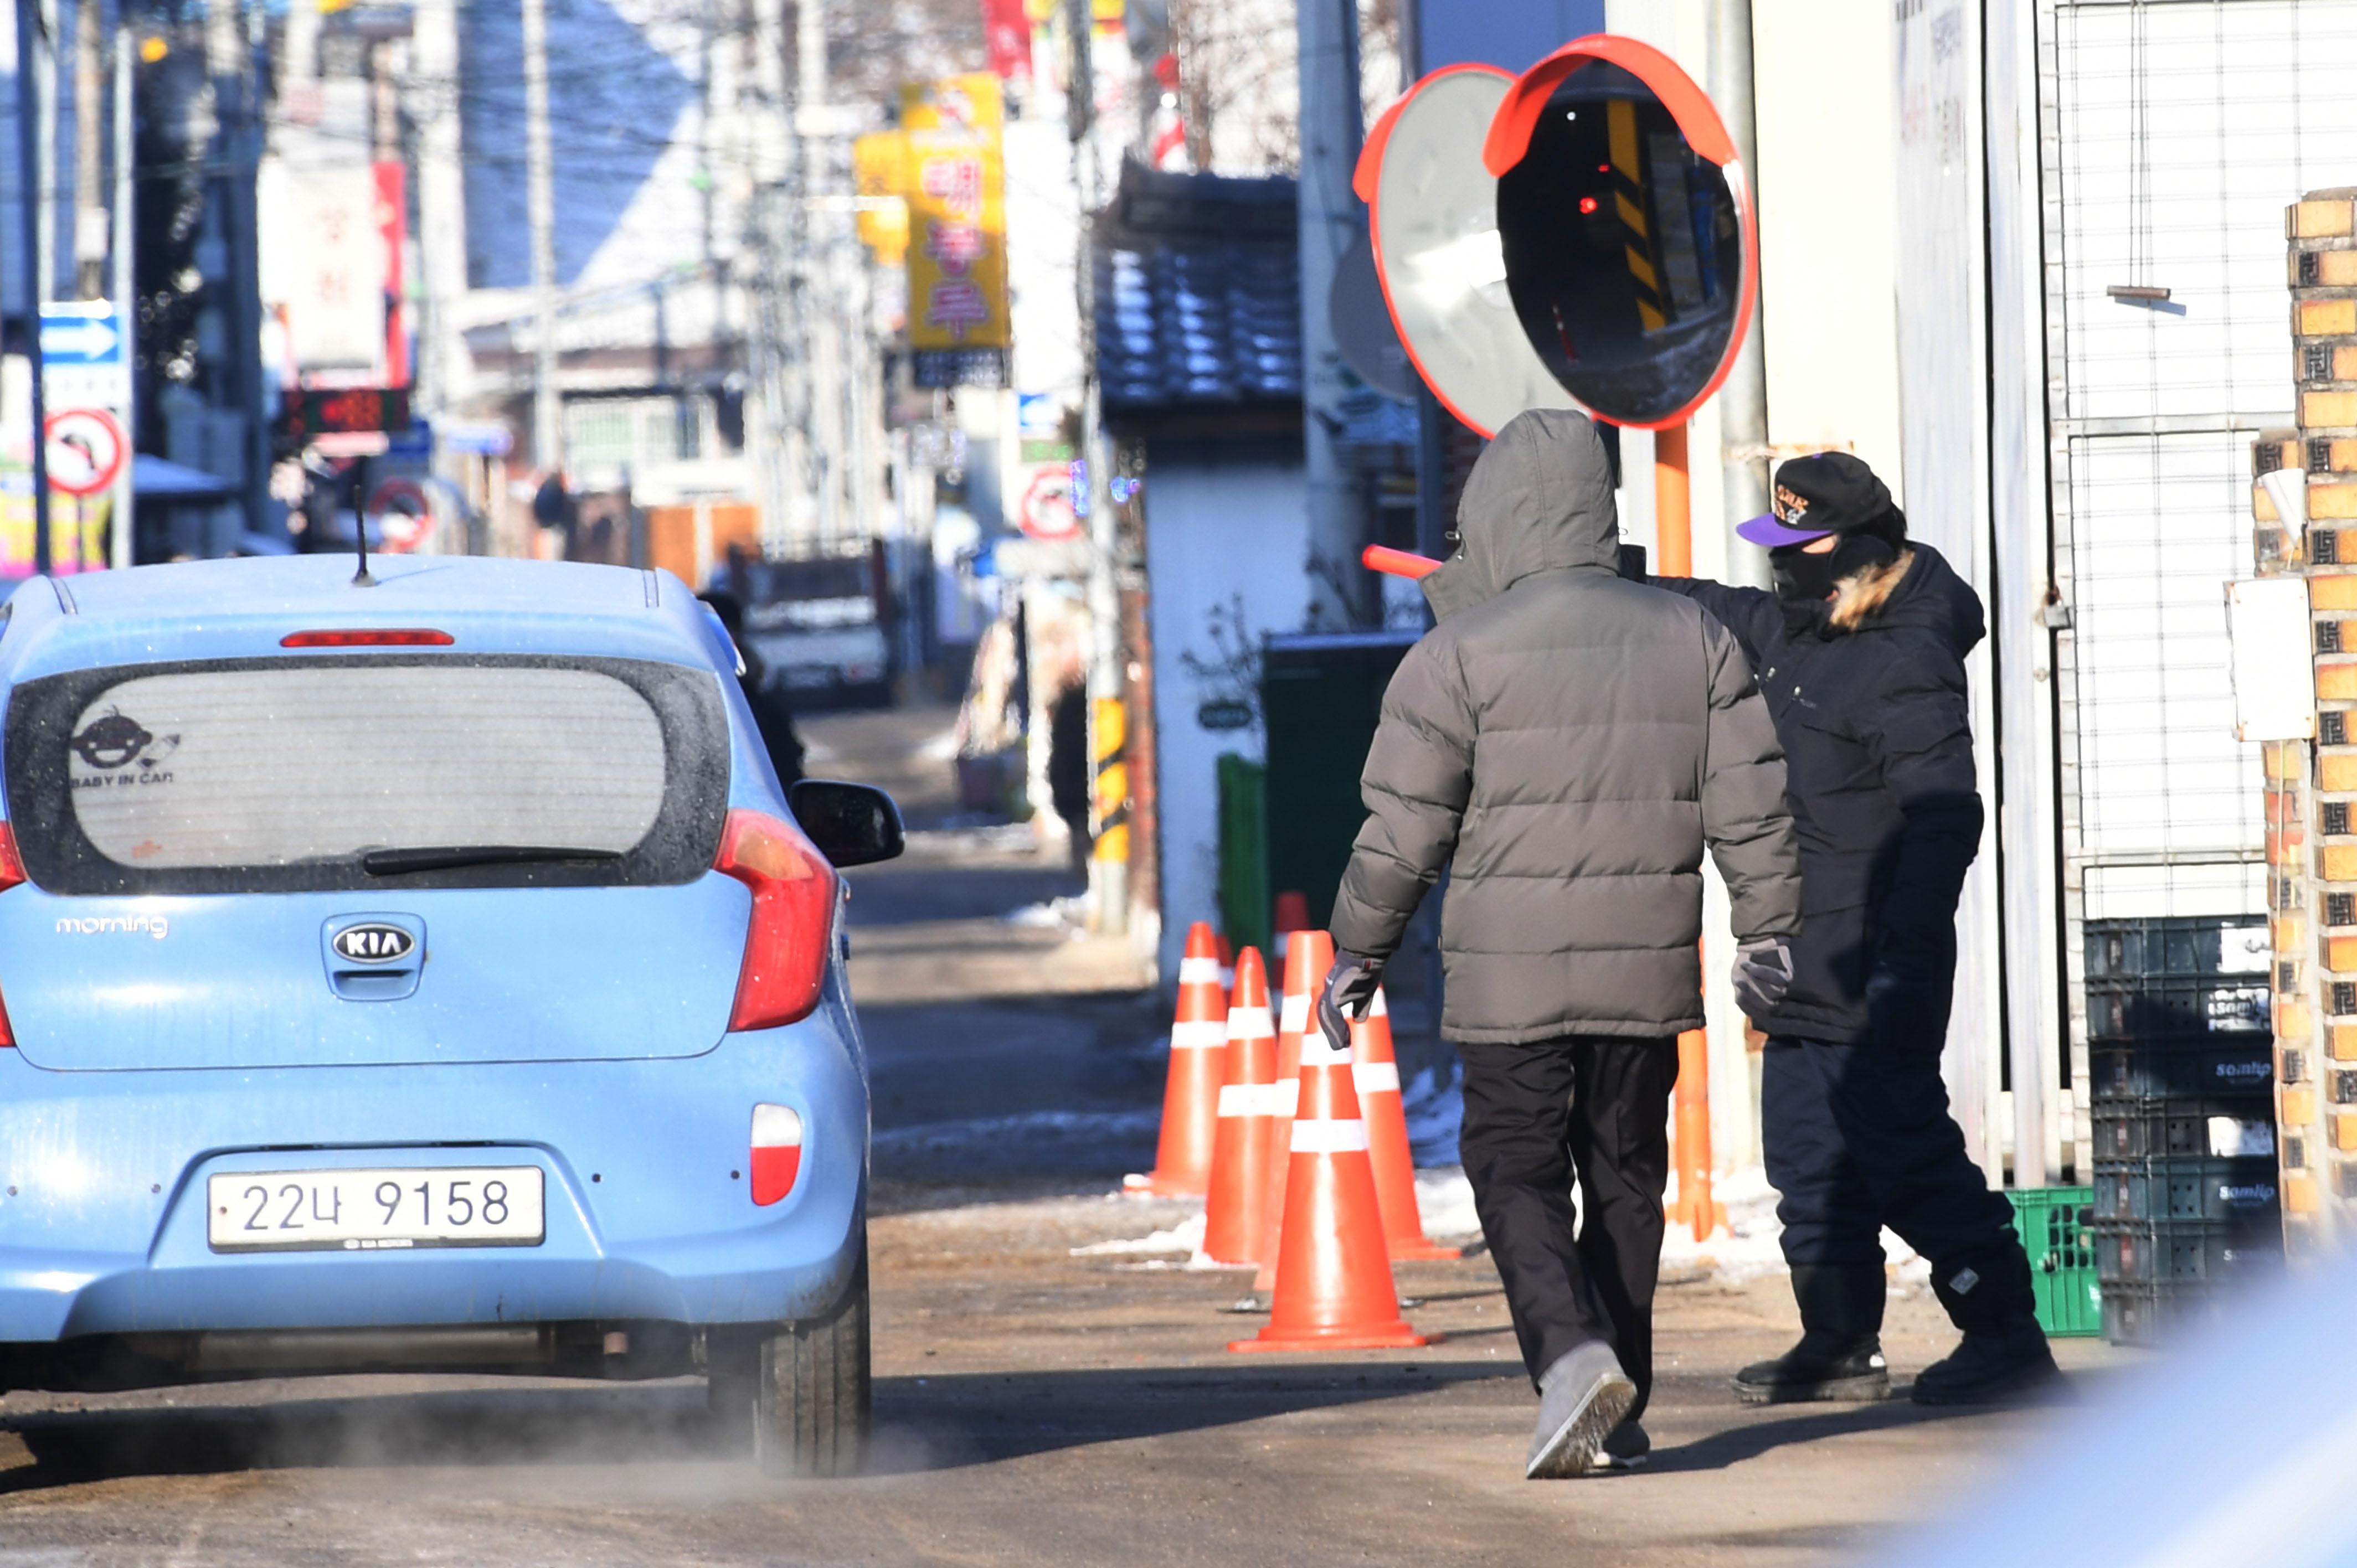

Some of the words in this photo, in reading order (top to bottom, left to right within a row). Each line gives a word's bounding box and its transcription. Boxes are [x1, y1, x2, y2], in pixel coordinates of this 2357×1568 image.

[70, 776, 112, 788] BABY
[118, 775, 134, 785] IN
[56, 916, 168, 940] morning
[347, 932, 402, 955] KIA
[244, 1184, 342, 1230] 22나
[375, 1180, 509, 1226] 9158
